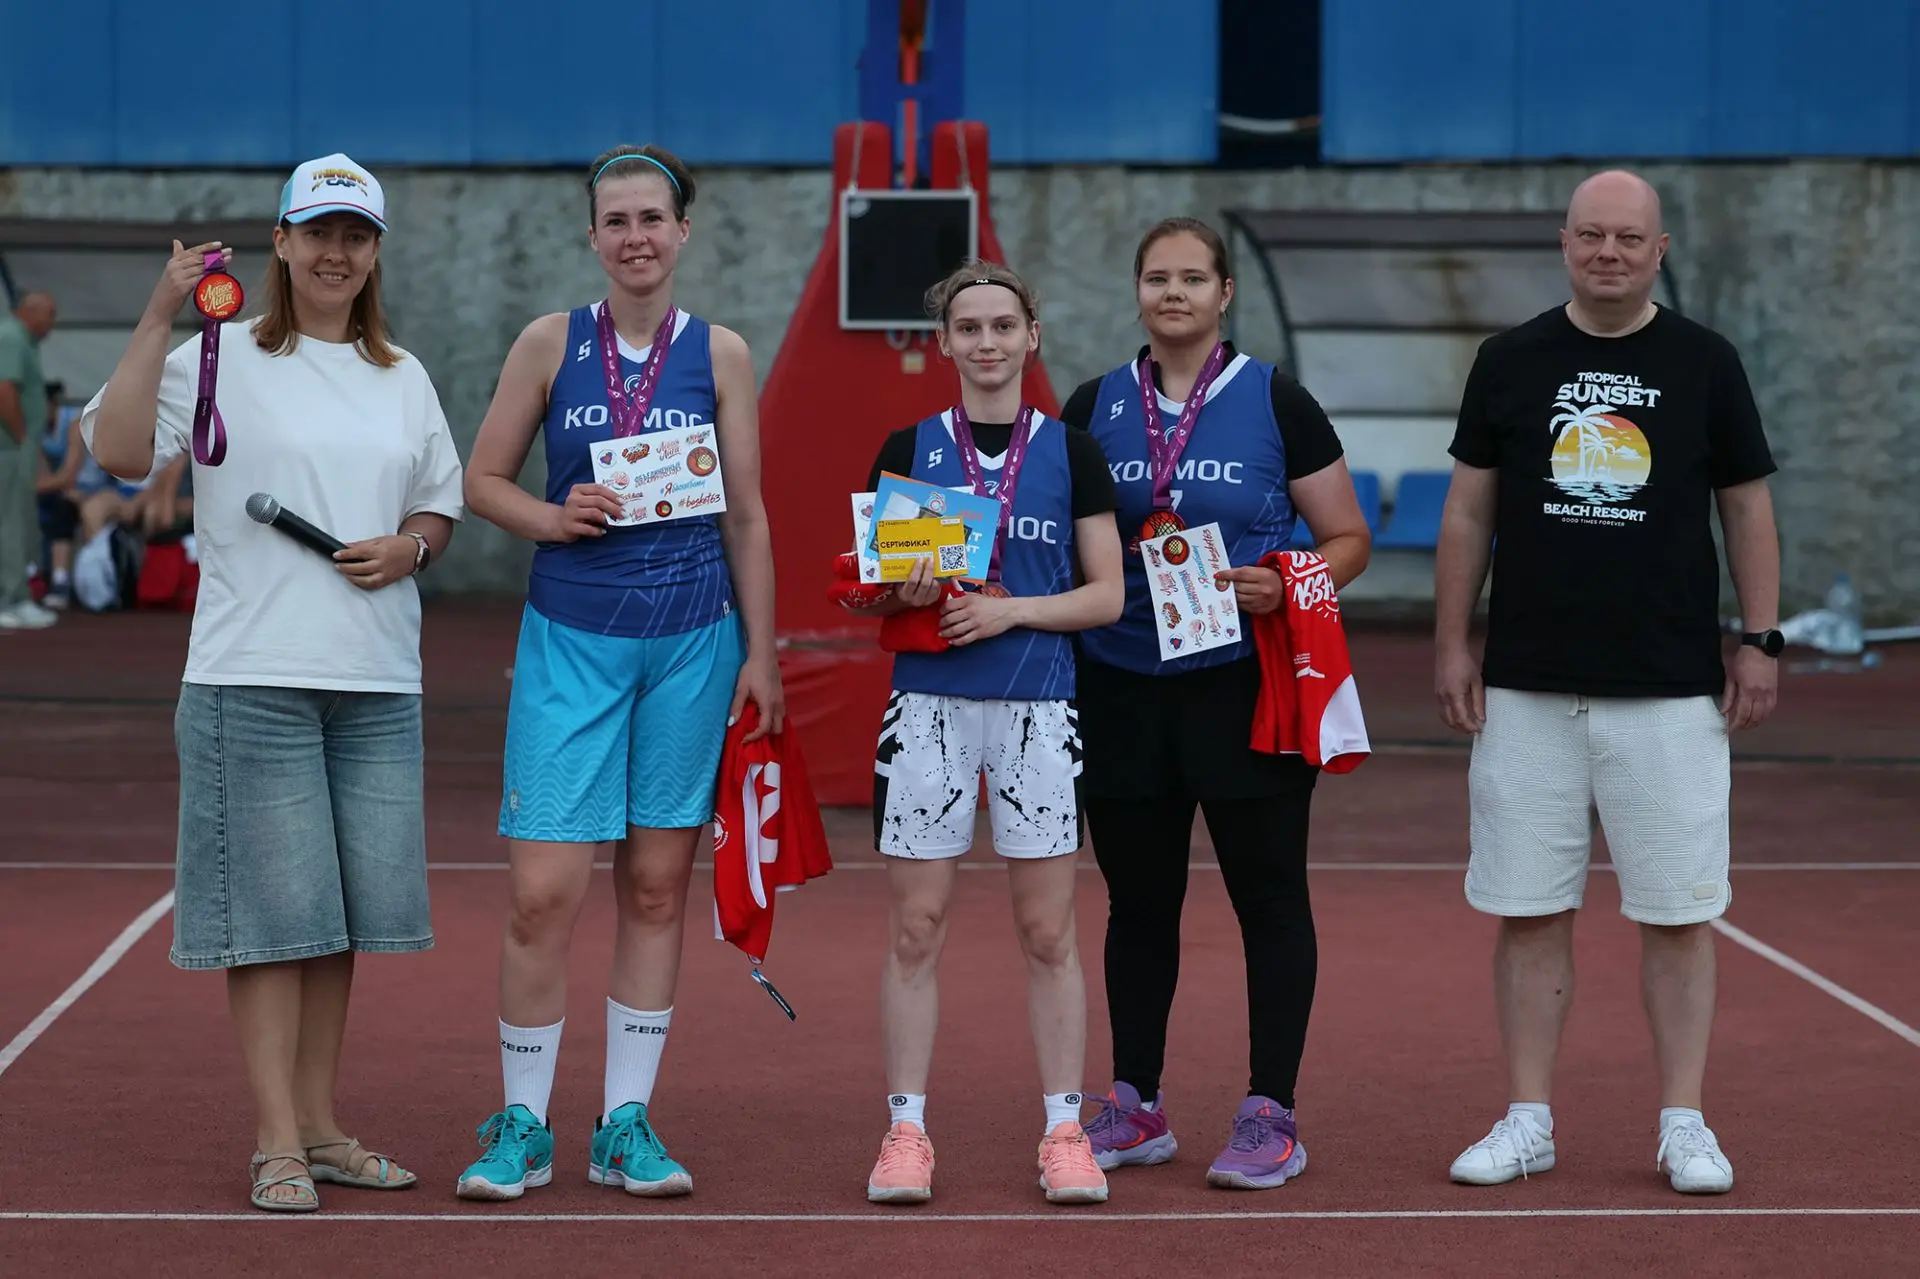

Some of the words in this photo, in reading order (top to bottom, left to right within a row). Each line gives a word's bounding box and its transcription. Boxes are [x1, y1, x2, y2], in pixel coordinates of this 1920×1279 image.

[1577, 372, 1642, 386] TROPICAL
[1555, 383, 1661, 407] SUNSET
[1543, 503, 1590, 517] BEACH
[1592, 506, 1646, 521] RESORT
[880, 540, 931, 549] СЕРТИФИКАТ
[624, 1024, 668, 1035] ZEDO
